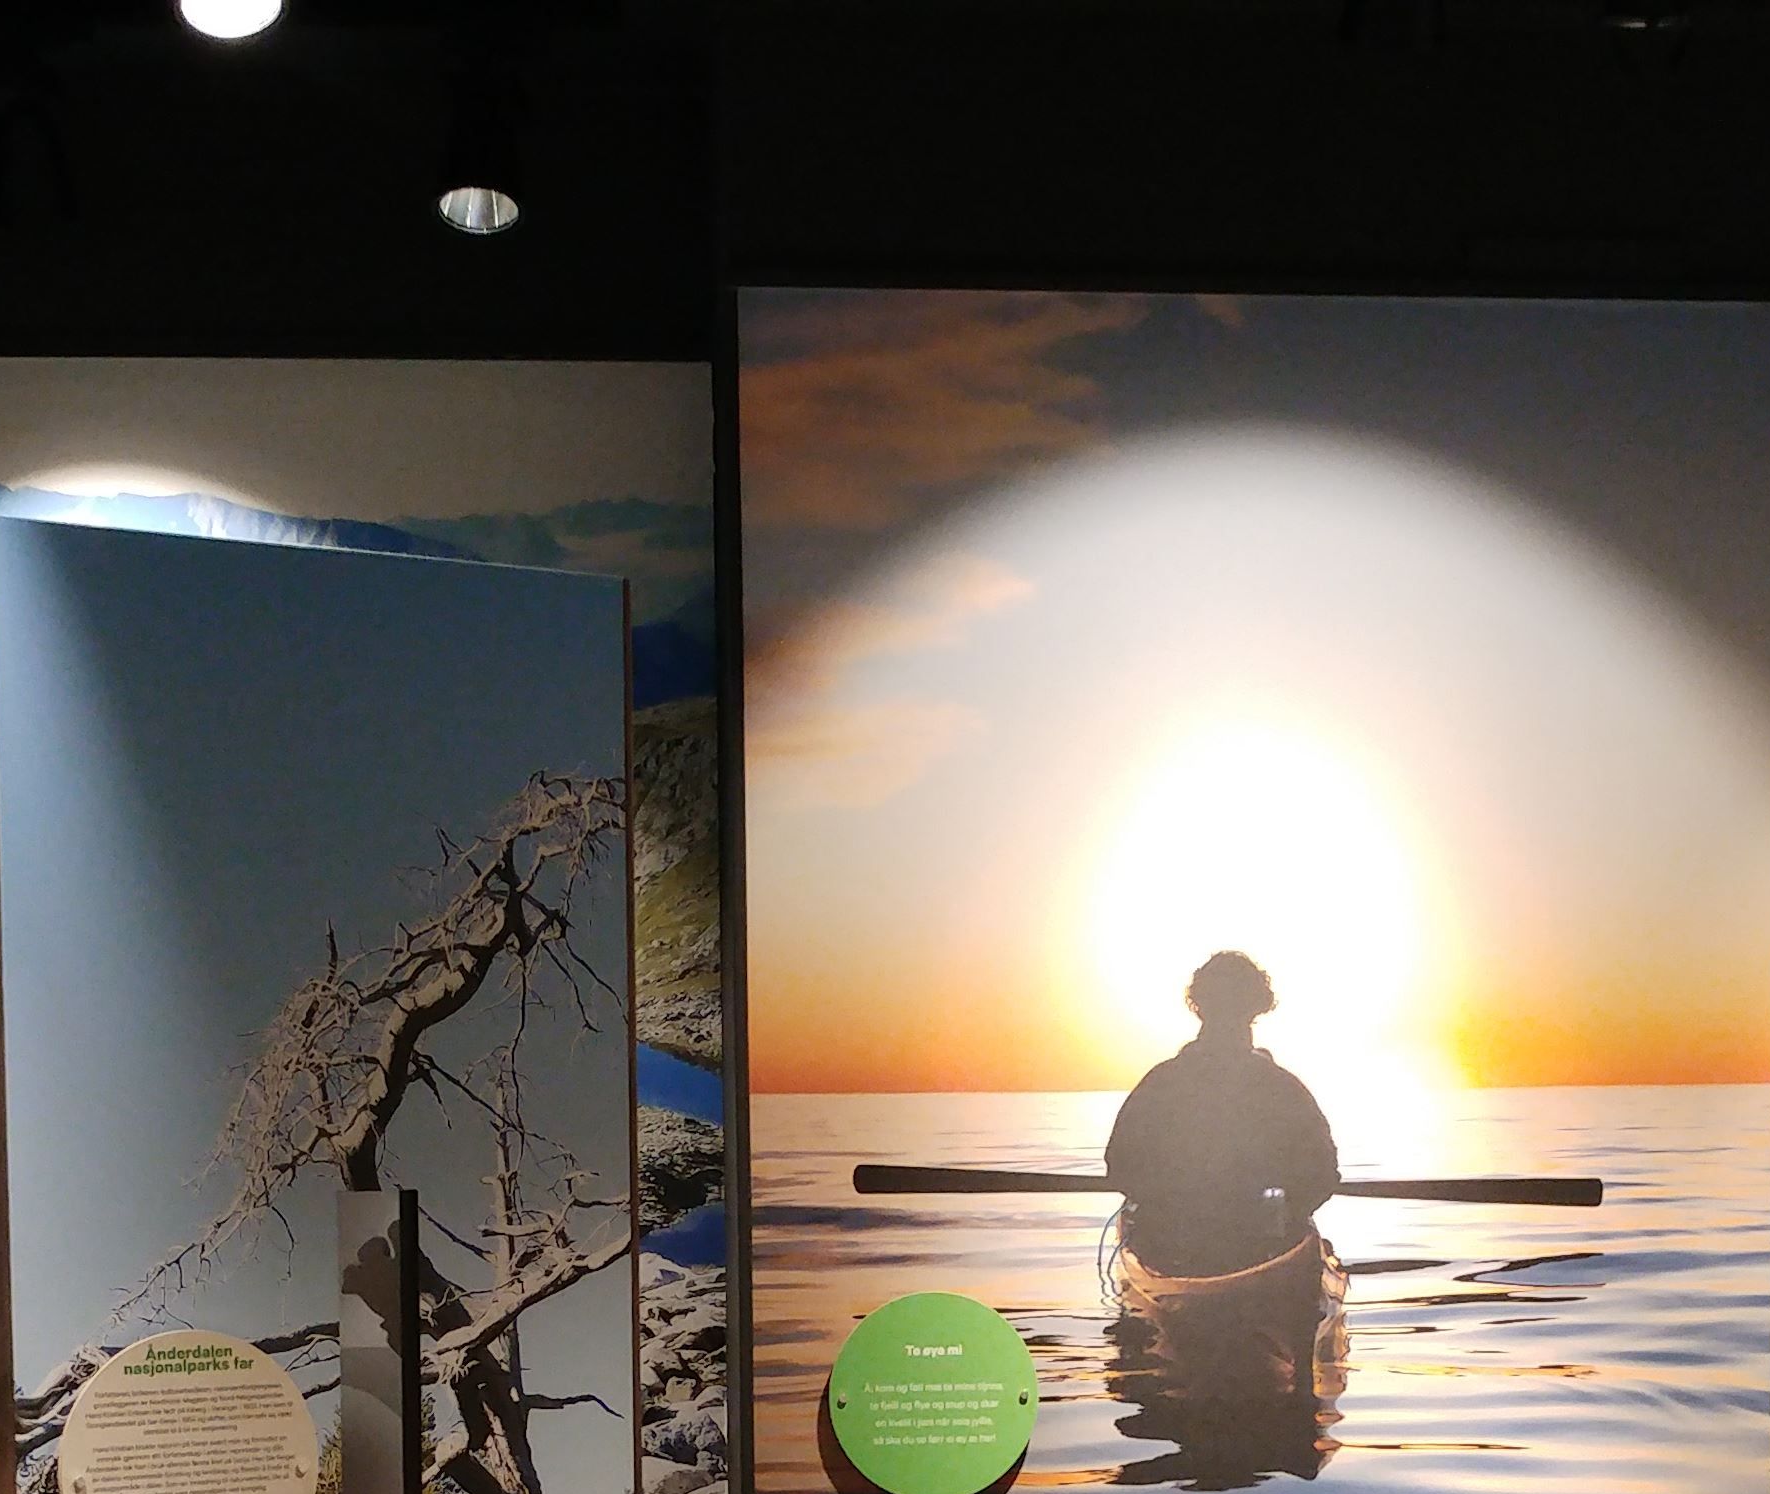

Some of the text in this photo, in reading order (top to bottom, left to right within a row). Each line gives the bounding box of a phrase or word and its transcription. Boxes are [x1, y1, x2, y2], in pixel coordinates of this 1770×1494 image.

[146, 1344, 232, 1360] Ånderdalen
[124, 1357, 254, 1377] nasjonalparks far
[896, 1385, 908, 1394] og
[900, 1402, 912, 1412] og
[932, 1402, 944, 1411] og
[967, 1401, 978, 1410] og
